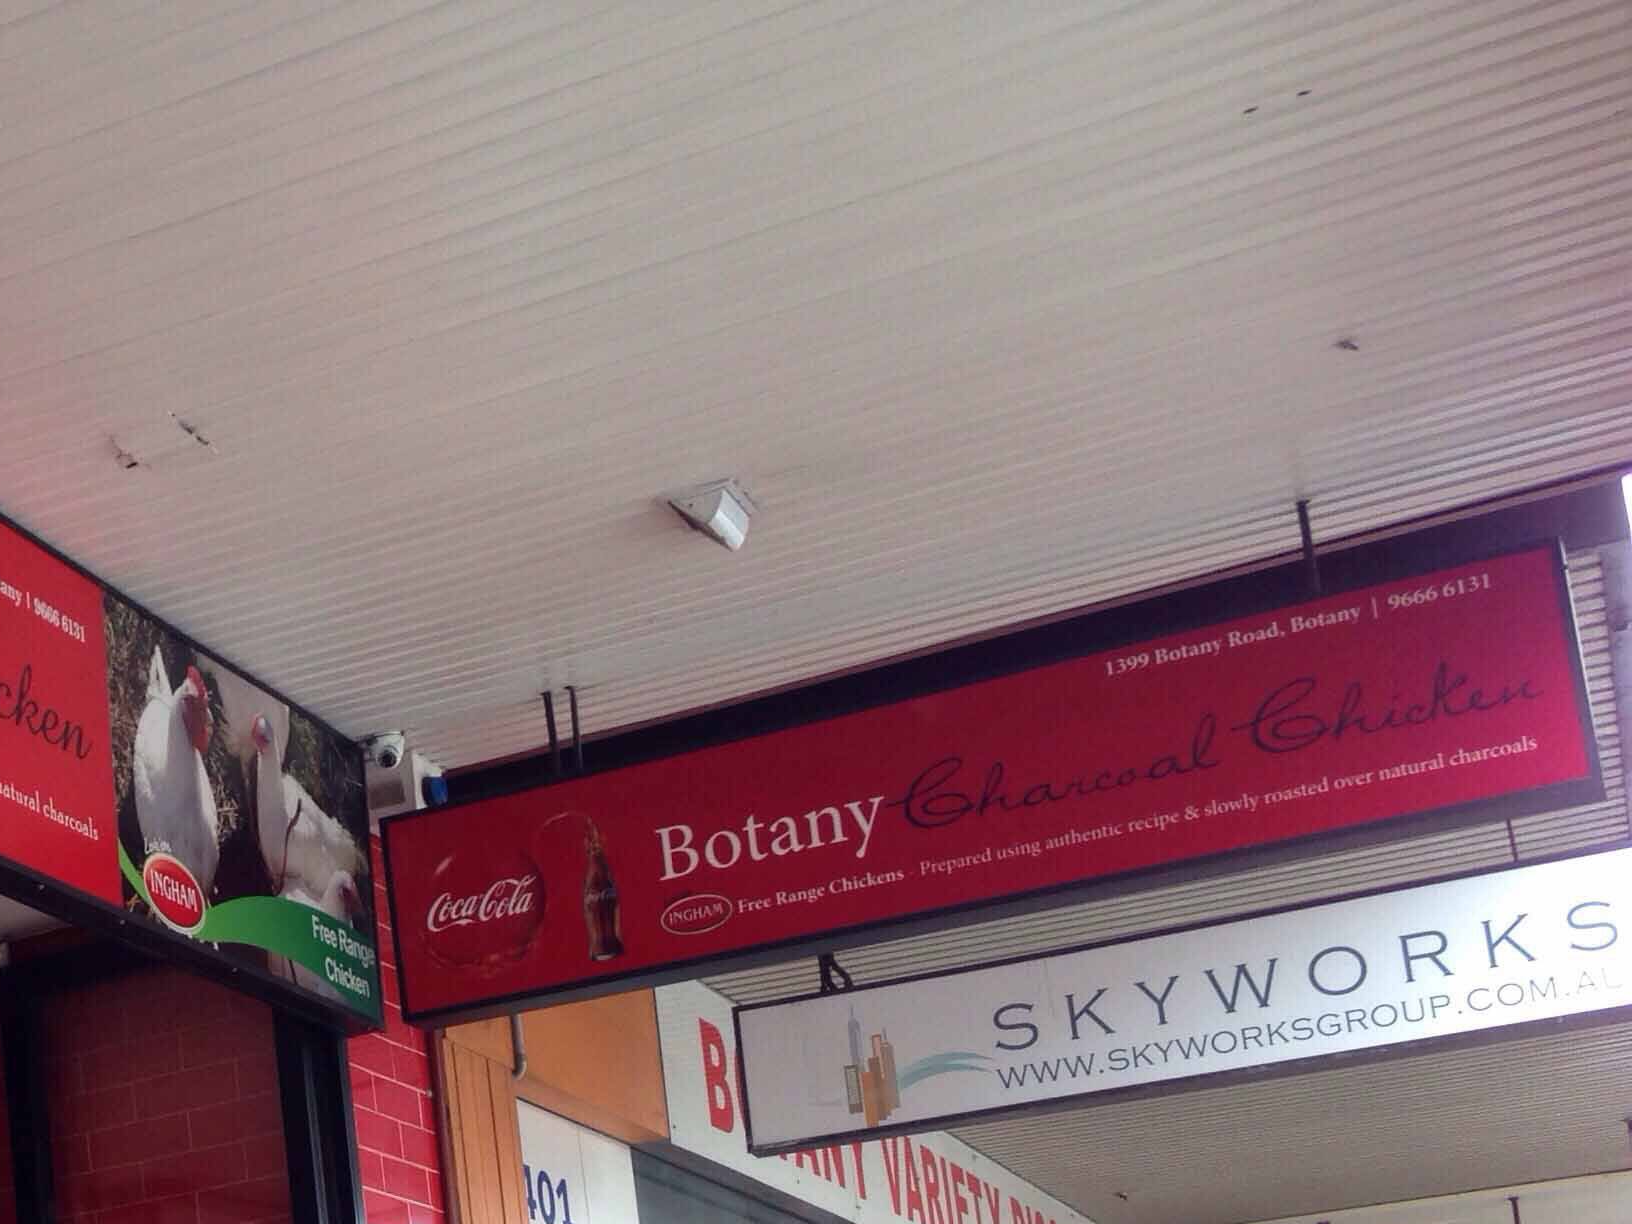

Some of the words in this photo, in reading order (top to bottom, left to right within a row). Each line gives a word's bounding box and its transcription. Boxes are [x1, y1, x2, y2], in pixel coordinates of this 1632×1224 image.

[32, 597, 61, 628] 9666
[60, 615, 87, 643] 6131
[1104, 652, 1150, 677] 1399
[1154, 638, 1224, 665] Botany
[1227, 621, 1286, 647] Road,
[1290, 604, 1362, 633] Botany
[1386, 587, 1439, 611] 9666
[1442, 572, 1492, 598] 6131
[886, 711, 1222, 829] Charcoal
[1231, 660, 1545, 753] Chicken
[42, 798, 99, 841] charcoals
[655, 795, 886, 881] Botany
[737, 897, 772, 915] Free
[774, 885, 826, 906] Range
[828, 867, 906, 895] Chickens
[918, 845, 993, 877] Prepared
[996, 837, 1042, 862] using
[1044, 822, 1123, 852] authentic
[1127, 808, 1180, 835] recipe
[1182, 804, 1201, 822] &
[1203, 791, 1260, 820] slowly
[1263, 775, 1330, 805] roasted
[1333, 770, 1374, 791] over
[1378, 752, 1445, 783] natural
[1448, 734, 1538, 767] charcoals
[149, 868, 199, 913] INGHAM
[426, 873, 536, 933] Coca-Cola
[667, 902, 725, 926] INGHAM
[311, 913, 338, 949] Free
[338, 927, 376, 969] Range
[324, 956, 371, 998] Chicken
[992, 900, 1619, 1051] SKYWORKS
